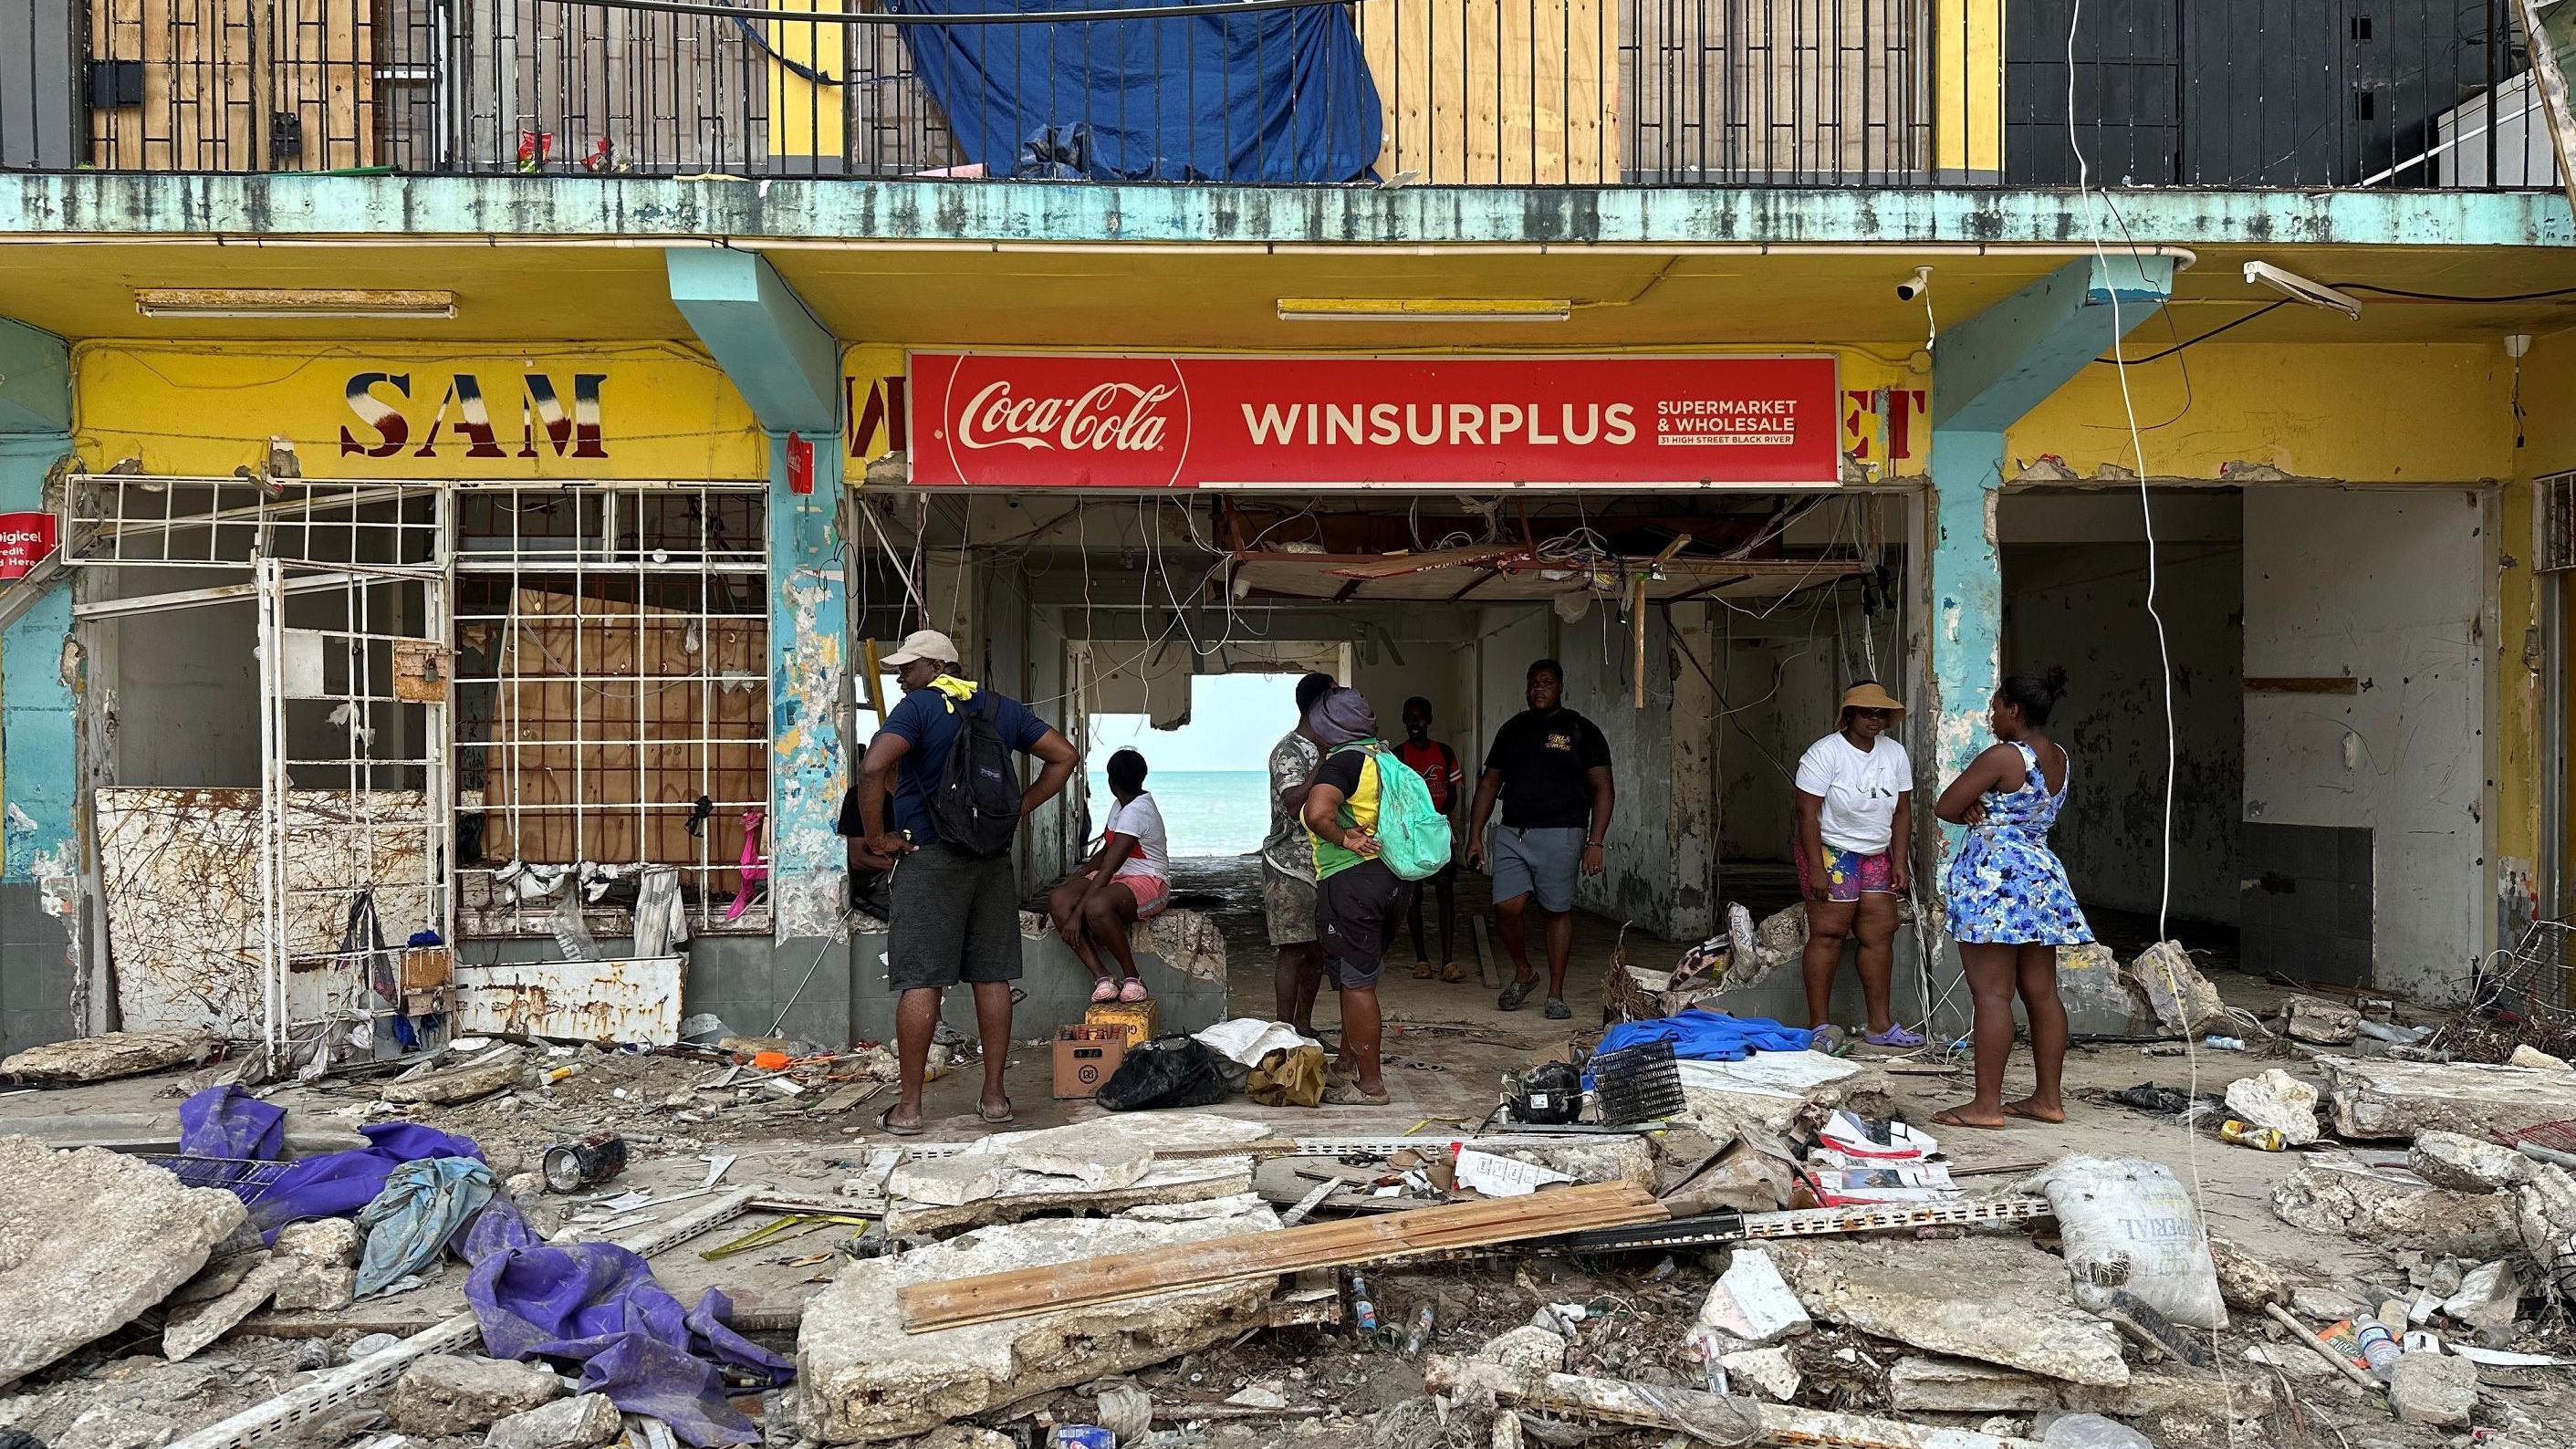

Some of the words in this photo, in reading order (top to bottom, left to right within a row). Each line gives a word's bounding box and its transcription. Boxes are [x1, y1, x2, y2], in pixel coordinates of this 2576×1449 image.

[340, 372, 609, 458] SAM
[958, 380, 1180, 452] Coca-Cola
[1657, 401, 1798, 415] SUPERMARKET
[1241, 403, 1636, 445] WINSURPLUS
[1657, 418, 1670, 432] &
[1674, 417, 1795, 432] WHOLESALE
[8, 558, 36, 567] Here
